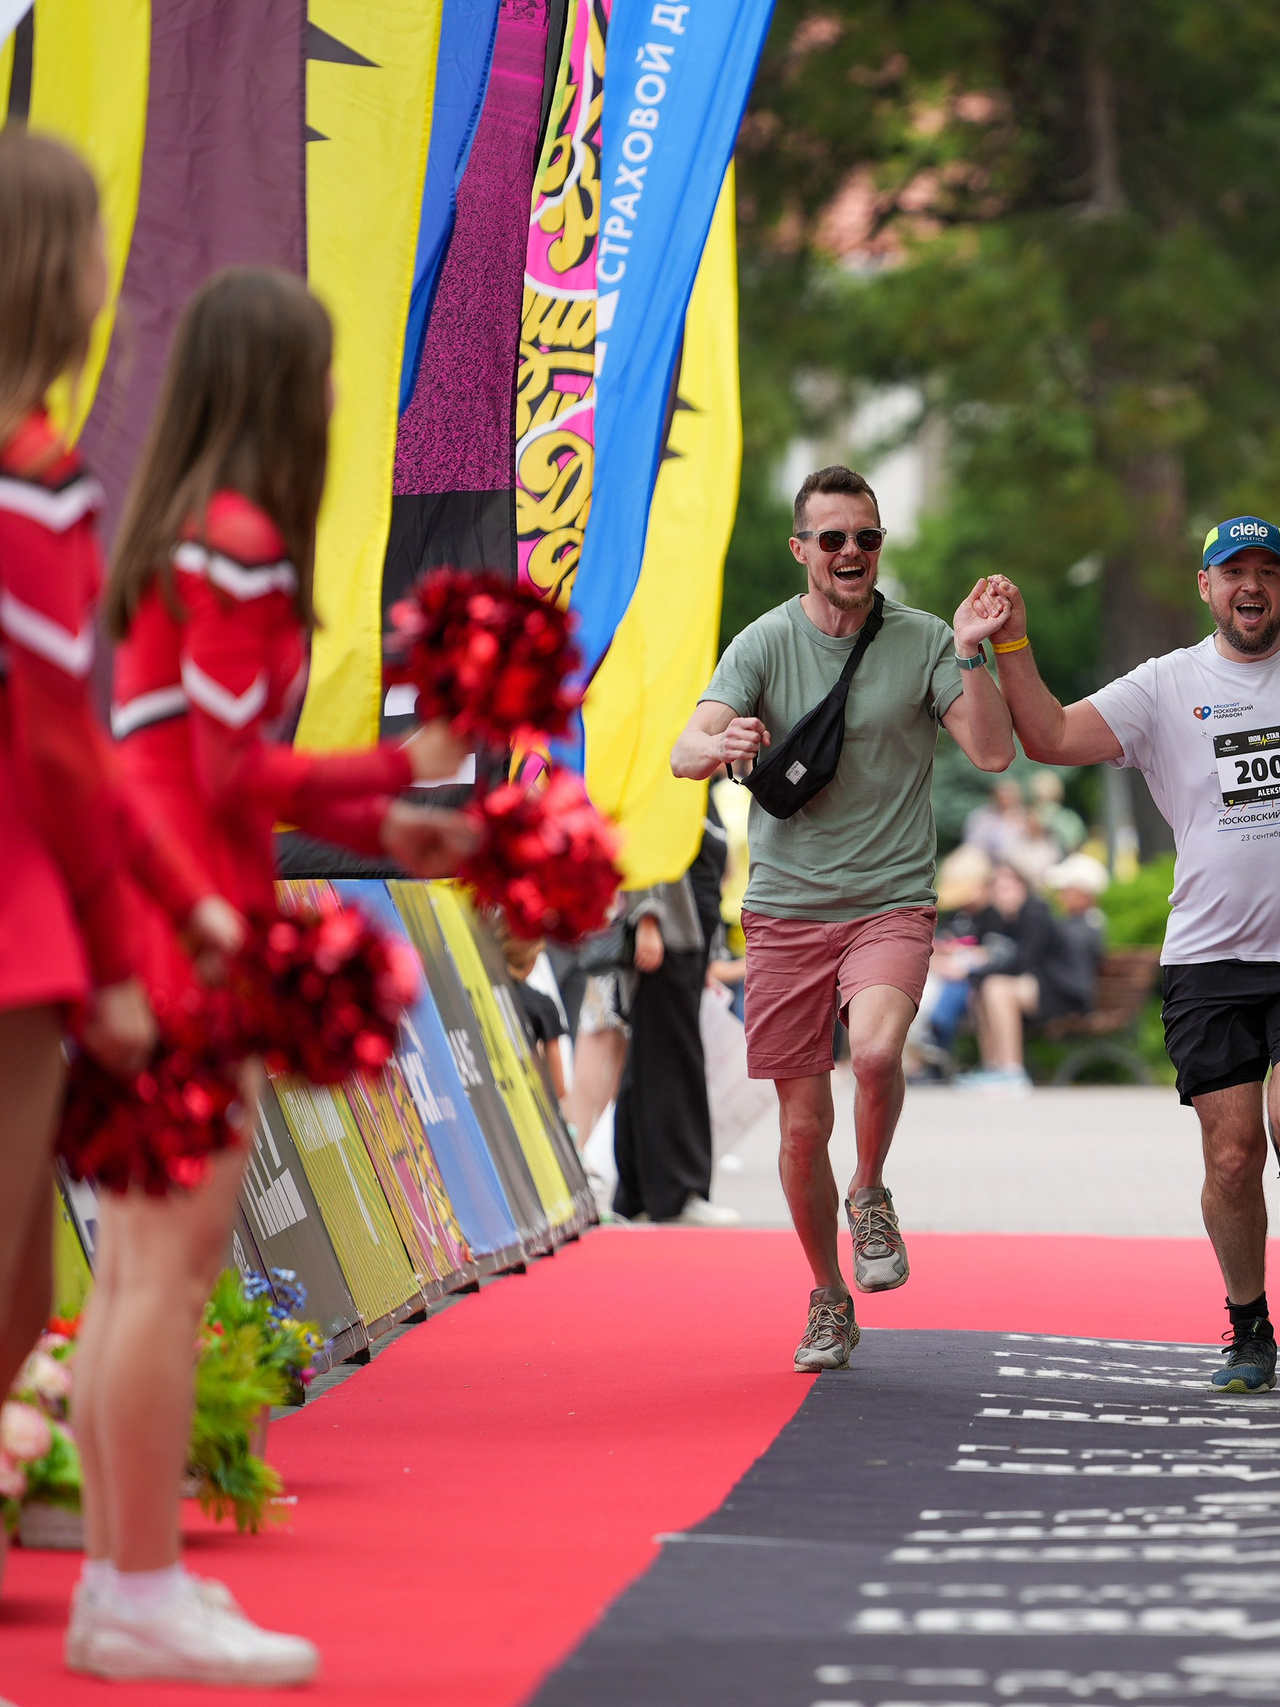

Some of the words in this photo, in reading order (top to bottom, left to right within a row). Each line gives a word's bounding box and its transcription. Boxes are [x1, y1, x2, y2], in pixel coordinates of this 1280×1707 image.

[596, 42, 675, 284] СТРАХОВОЙ
[651, 0, 690, 35] Д
[1230, 522, 1268, 538] ciele
[1266, 731, 1280, 739] STAR
[1240, 834, 1250, 842] 23
